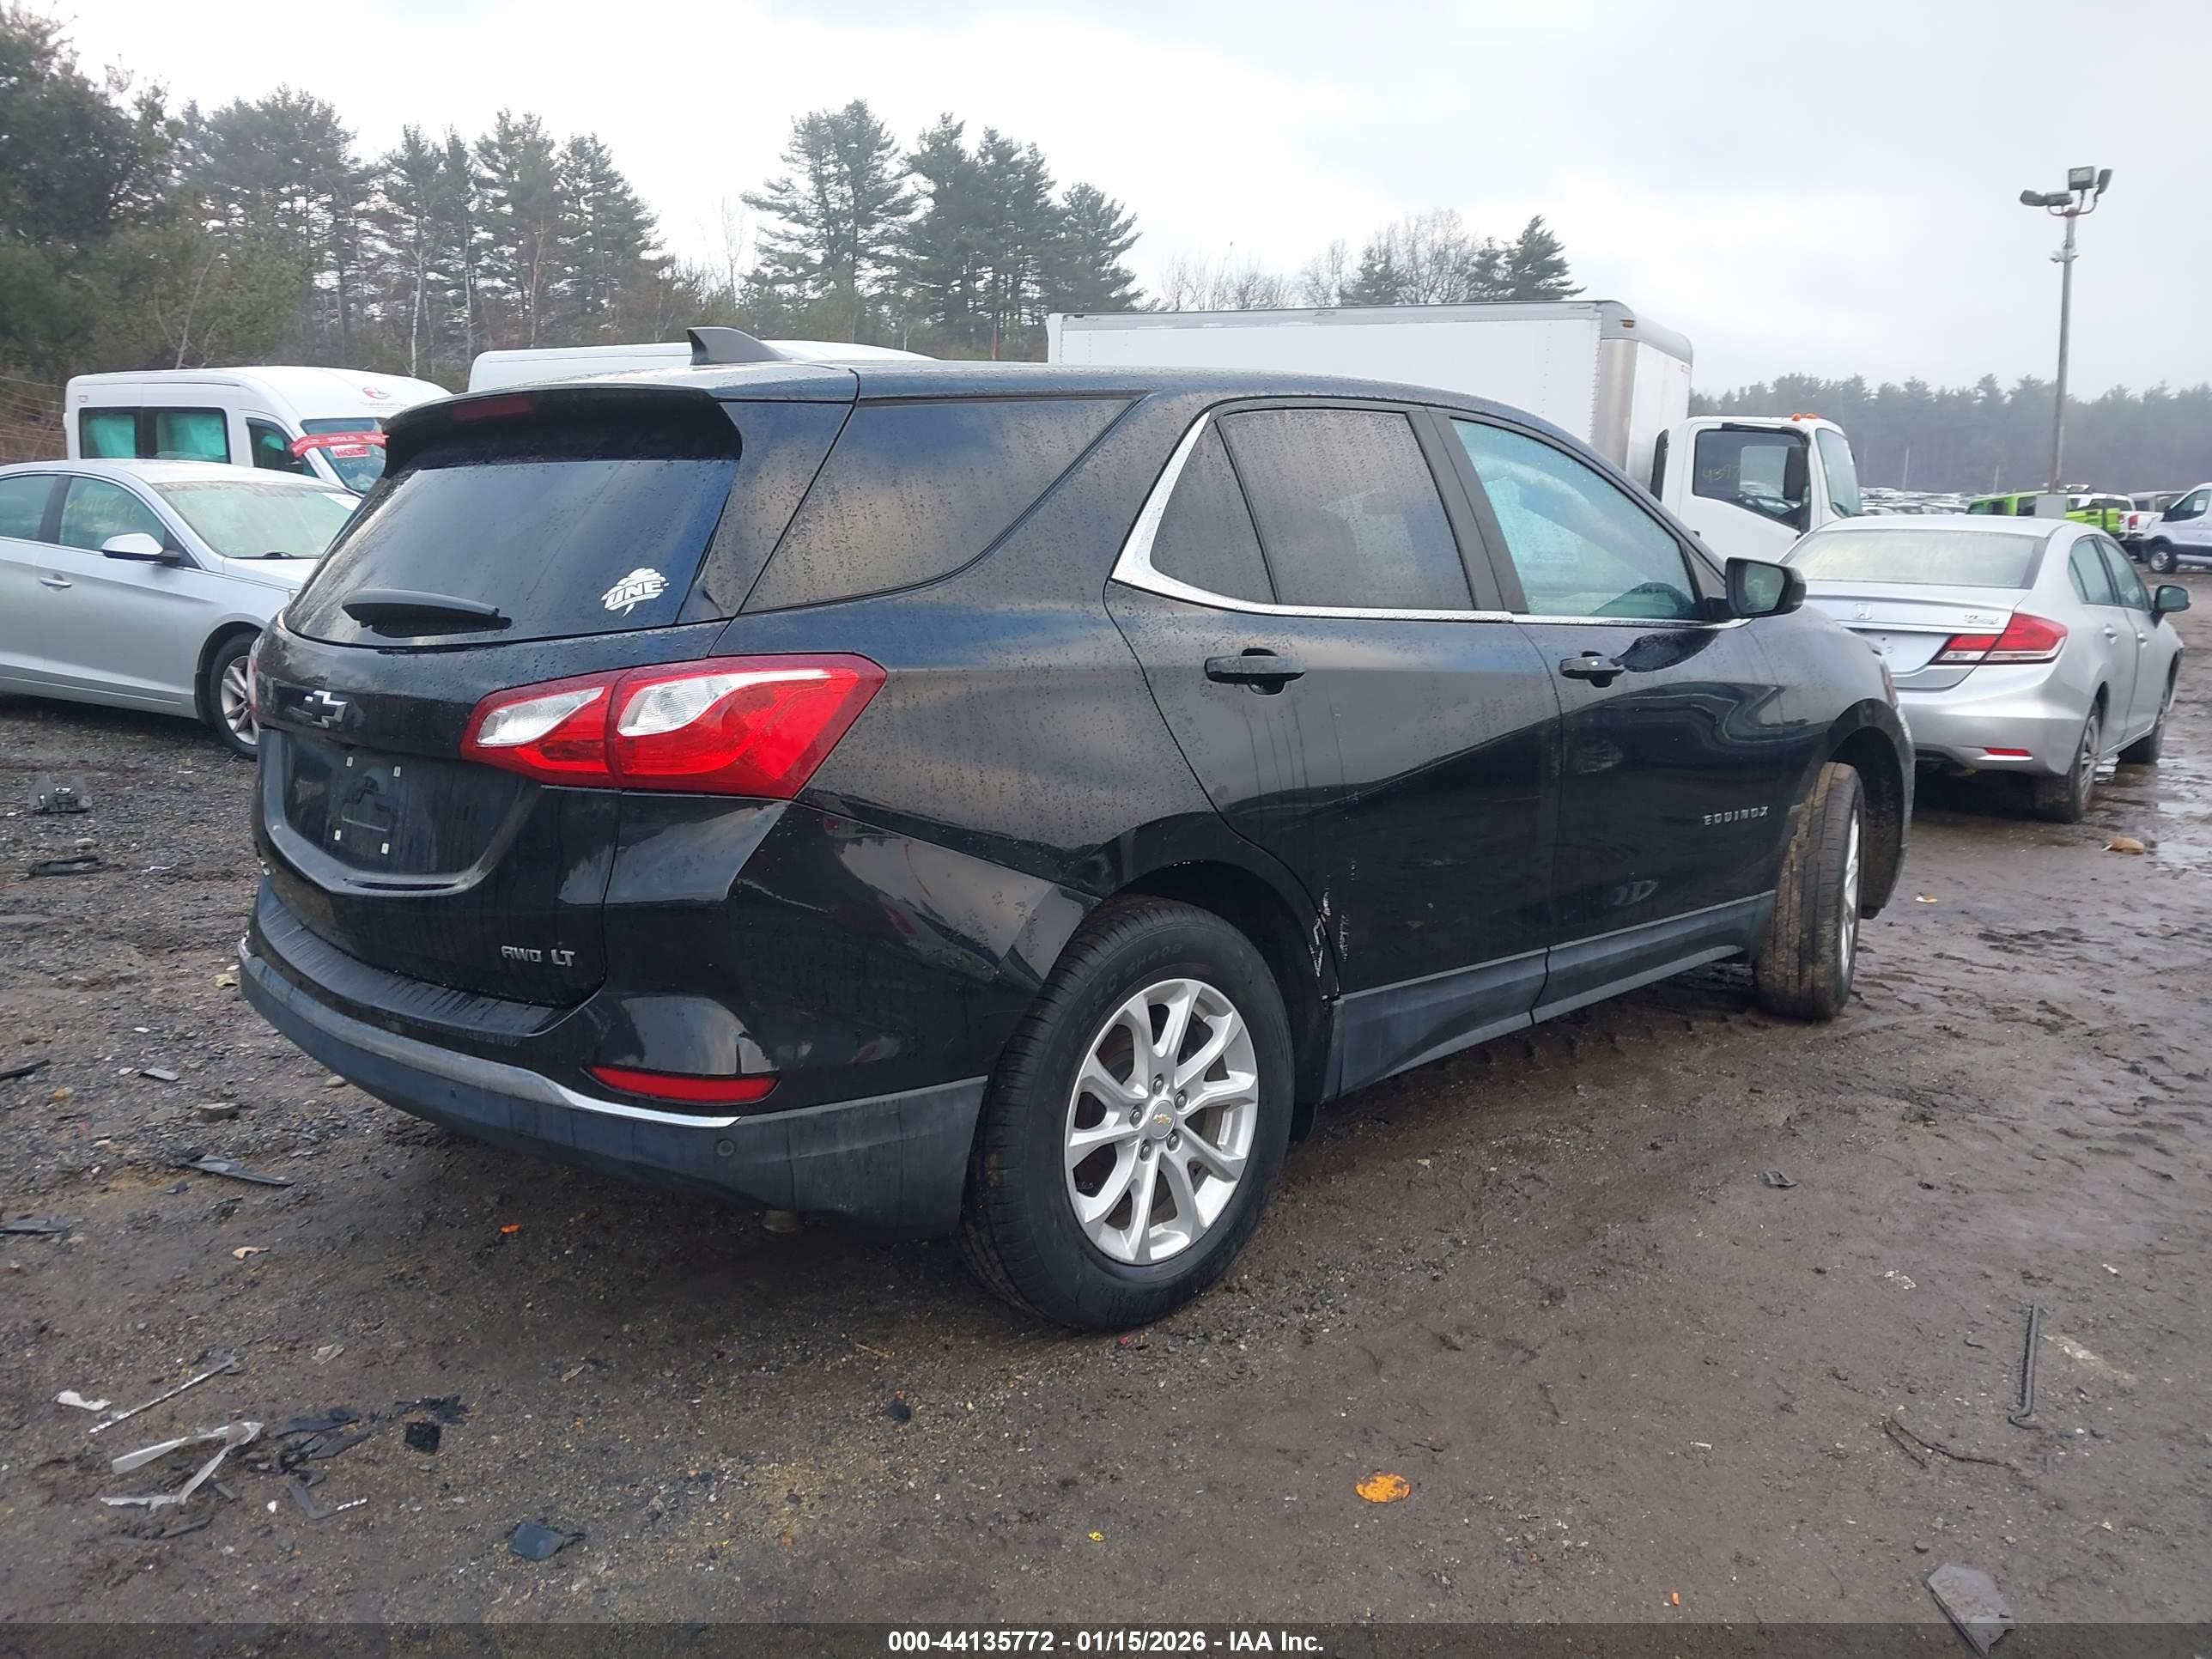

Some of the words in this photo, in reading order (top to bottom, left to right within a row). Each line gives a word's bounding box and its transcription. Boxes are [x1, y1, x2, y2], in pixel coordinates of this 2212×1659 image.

[605, 580, 664, 608] UNE
[1704, 806, 1769, 825] EQUINOX
[501, 945, 542, 962] AWD
[550, 949, 575, 967] LT
